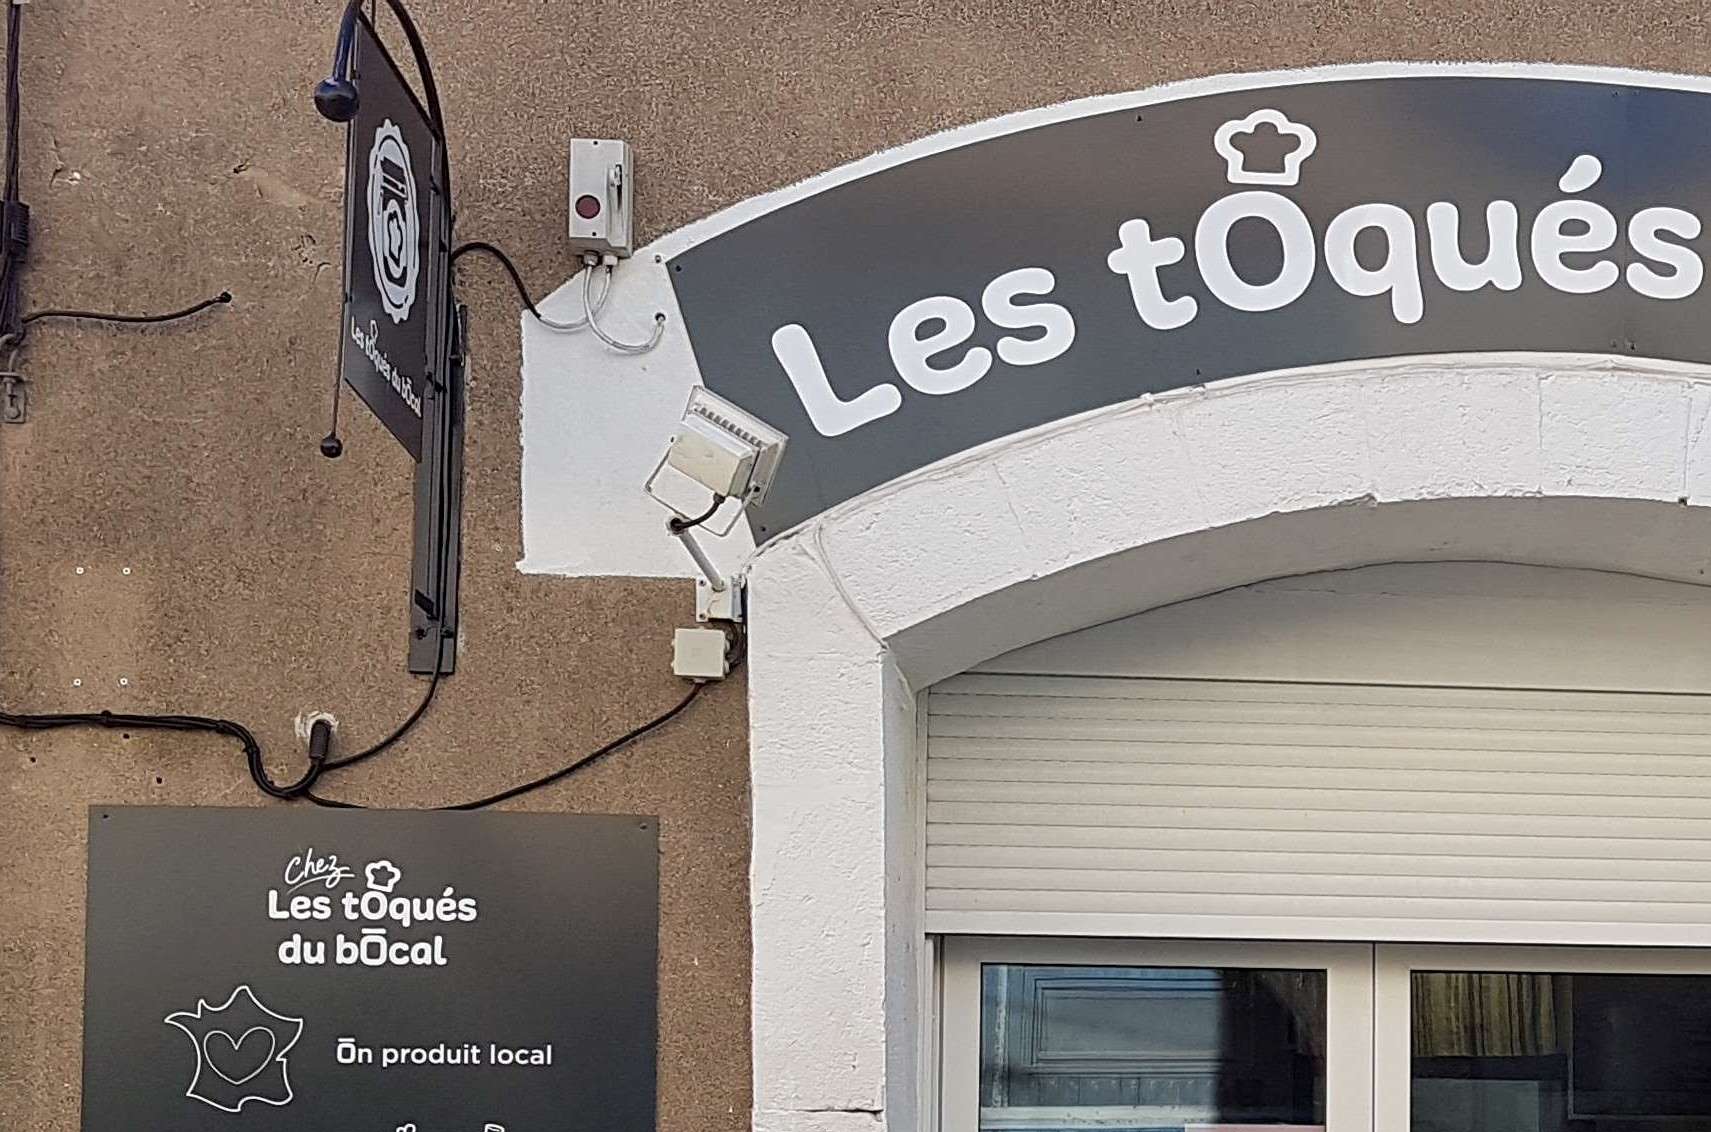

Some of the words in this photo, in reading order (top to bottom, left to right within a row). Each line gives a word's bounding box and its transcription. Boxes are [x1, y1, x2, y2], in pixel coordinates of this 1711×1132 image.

[765, 267, 1081, 446] Les
[284, 847, 355, 889] Chez
[268, 887, 332, 920] Les
[278, 933, 325, 965] du
[382, 1043, 481, 1068] produit
[490, 1043, 552, 1065] local
